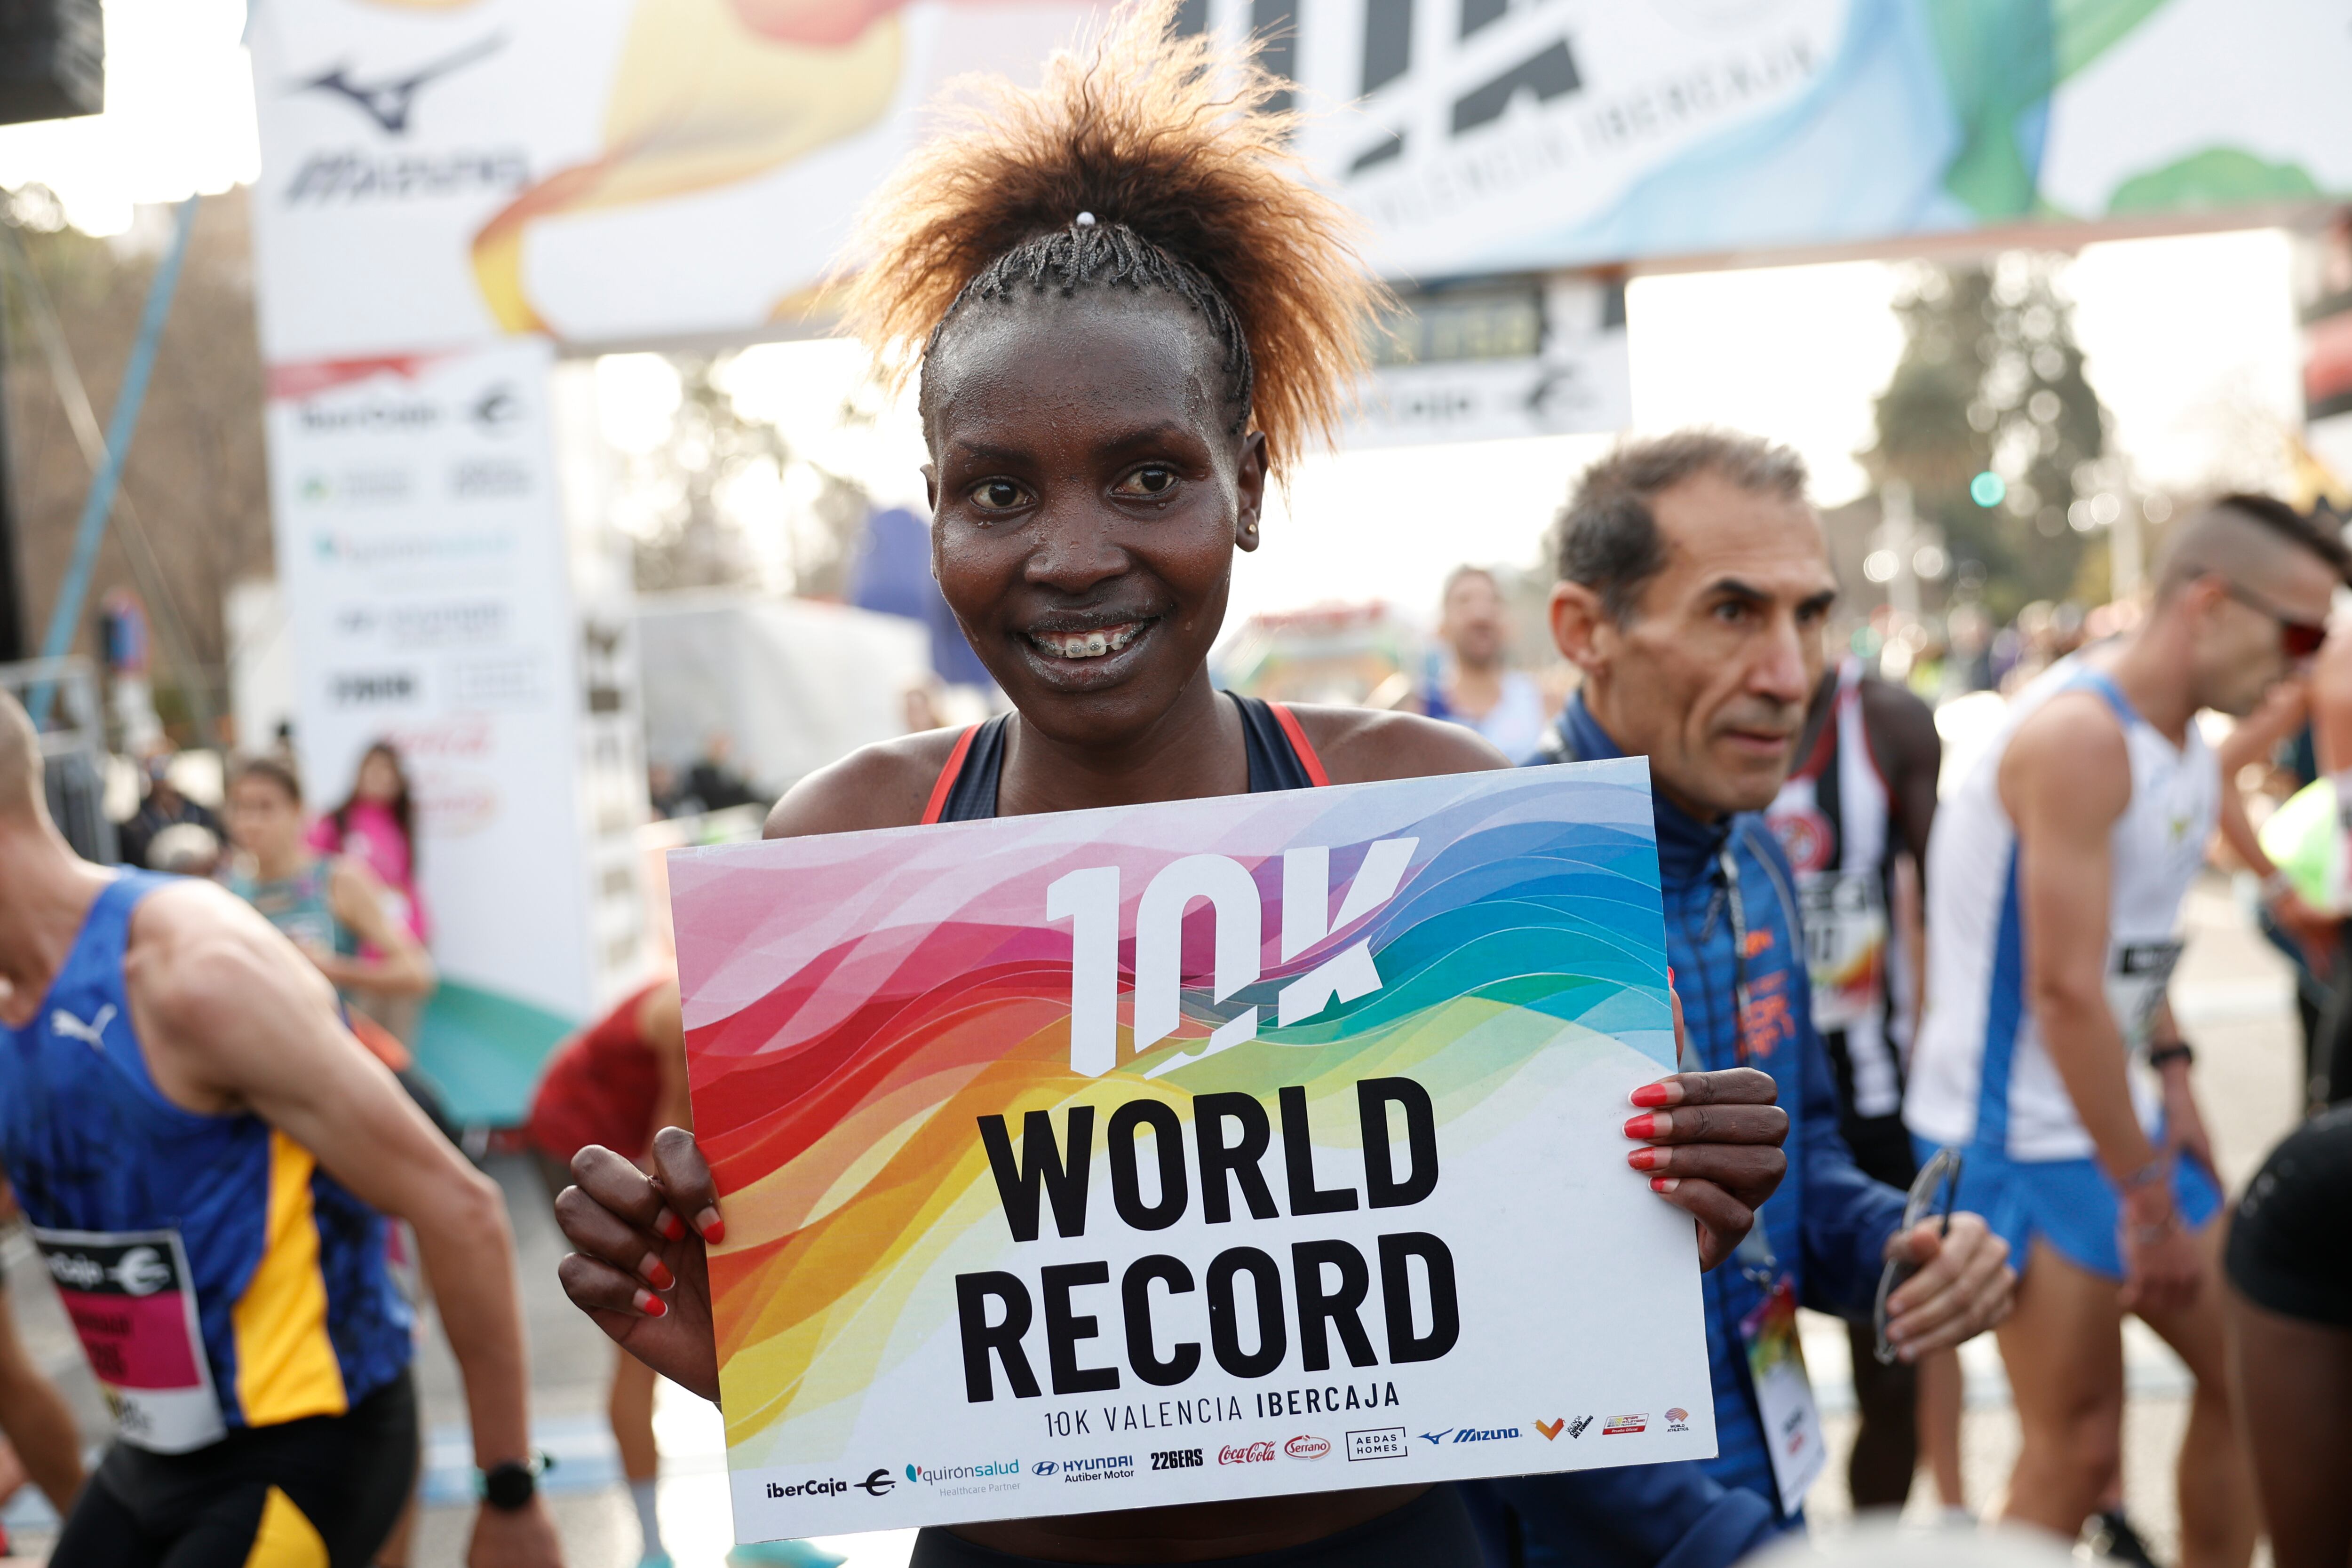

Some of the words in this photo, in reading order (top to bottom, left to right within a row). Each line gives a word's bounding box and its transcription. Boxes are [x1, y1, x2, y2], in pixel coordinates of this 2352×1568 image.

[1047, 837, 1419, 1080] 10K
[977, 1077, 1438, 1242] WORLD
[955, 1231, 1460, 1402] RECORD
[1045, 1410, 1090, 1437] 10K
[1104, 1395, 1242, 1431] VALENCIA
[1256, 1381, 1399, 1418] IBERCAJA
[1569, 1421, 1583, 1436] CIUDAD
[1573, 1430, 1581, 1439] DEL
[1356, 1433, 1397, 1444] AEDAS
[1217, 1441, 1276, 1465] Coca-Cola
[1289, 1442, 1327, 1454] Serrano
[1357, 1444, 1398, 1454] HOMES
[1063, 1455, 1133, 1472] HYUNDAI
[1151, 1448, 1203, 1470] 226ERS
[1065, 1472, 1102, 1483] Autiber
[1104, 1469, 1135, 1480] Motor
[766, 1477, 847, 1498] iberCaja
[940, 1485, 986, 1497] Healthcare
[989, 1483, 1020, 1492] Partner
